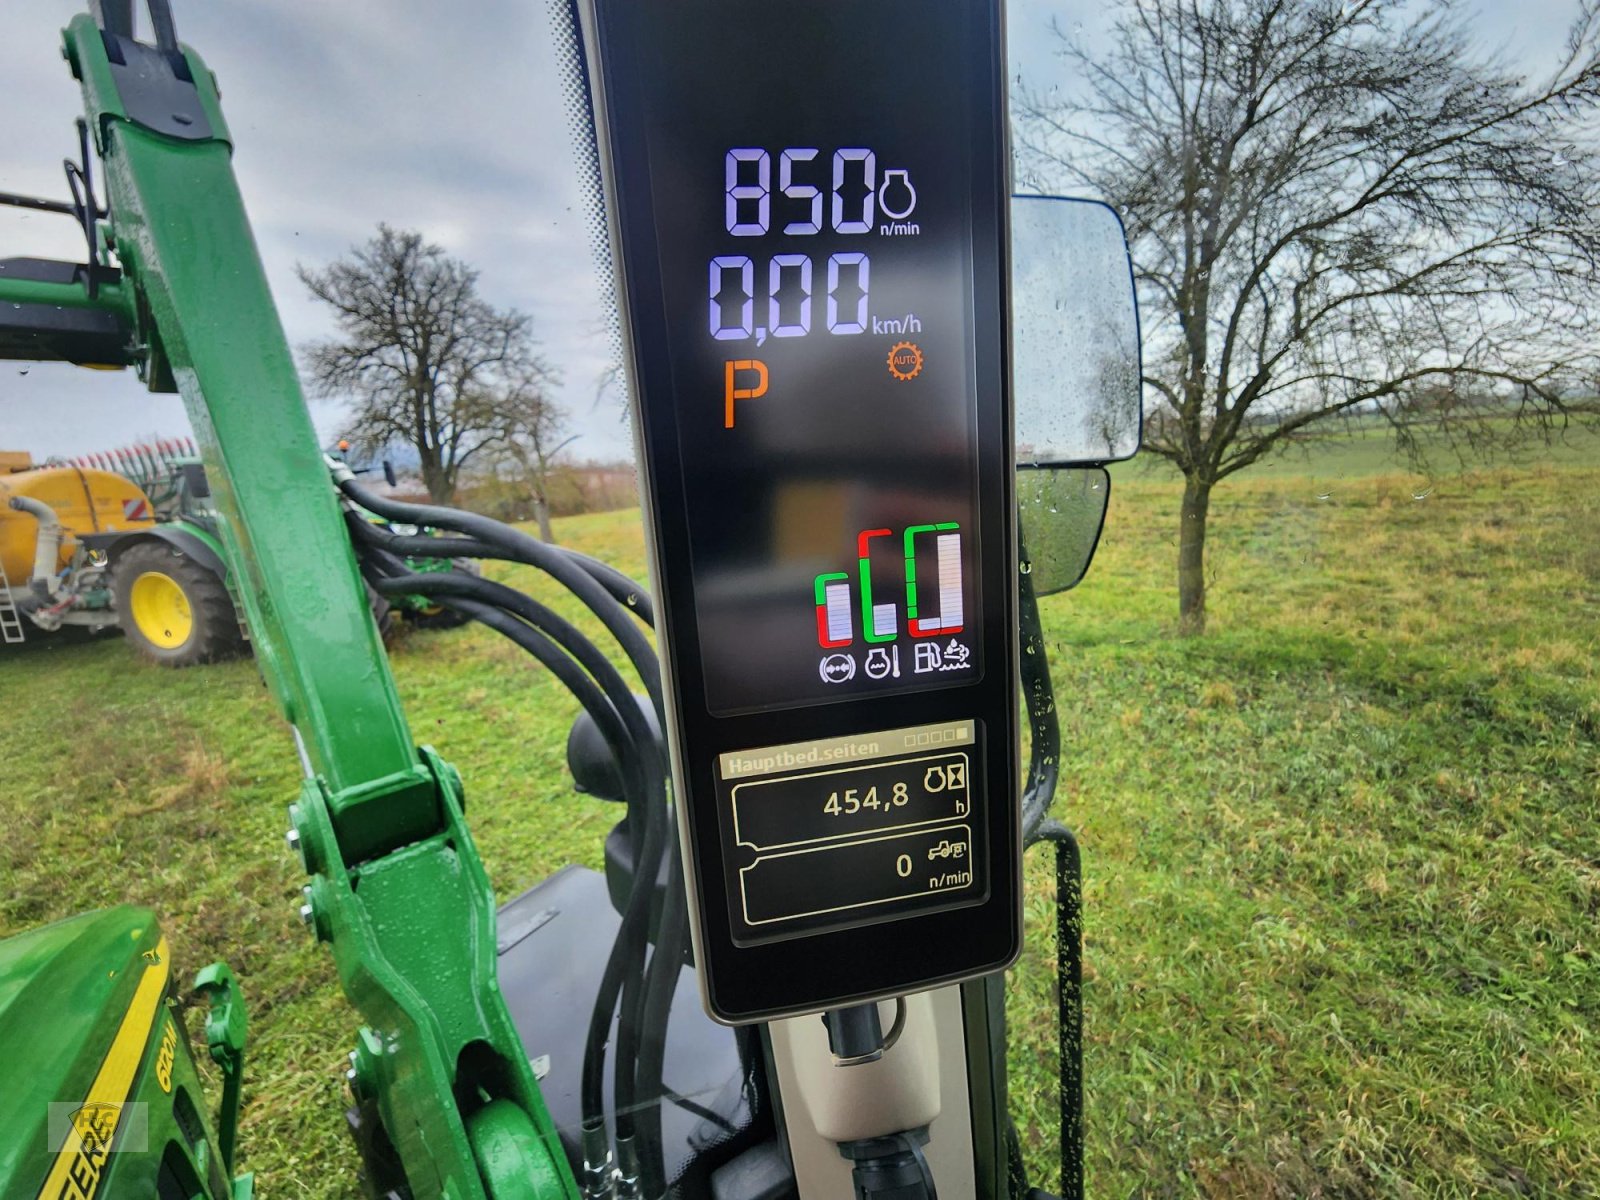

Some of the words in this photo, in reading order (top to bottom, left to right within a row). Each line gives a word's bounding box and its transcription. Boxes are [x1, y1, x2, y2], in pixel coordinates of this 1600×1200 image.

[725, 147, 876, 236] 850
[880, 221, 920, 236] n/min
[709, 252, 870, 347] 0,00
[873, 314, 922, 335] km/h
[894, 355, 917, 365] AUTO
[724, 359, 769, 428] P
[729, 742, 880, 773] Hauptbed.seiten
[823, 782, 909, 816] 454,8
[955, 800, 965, 814] h
[896, 854, 913, 877] 0
[929, 870, 970, 888] n/min
